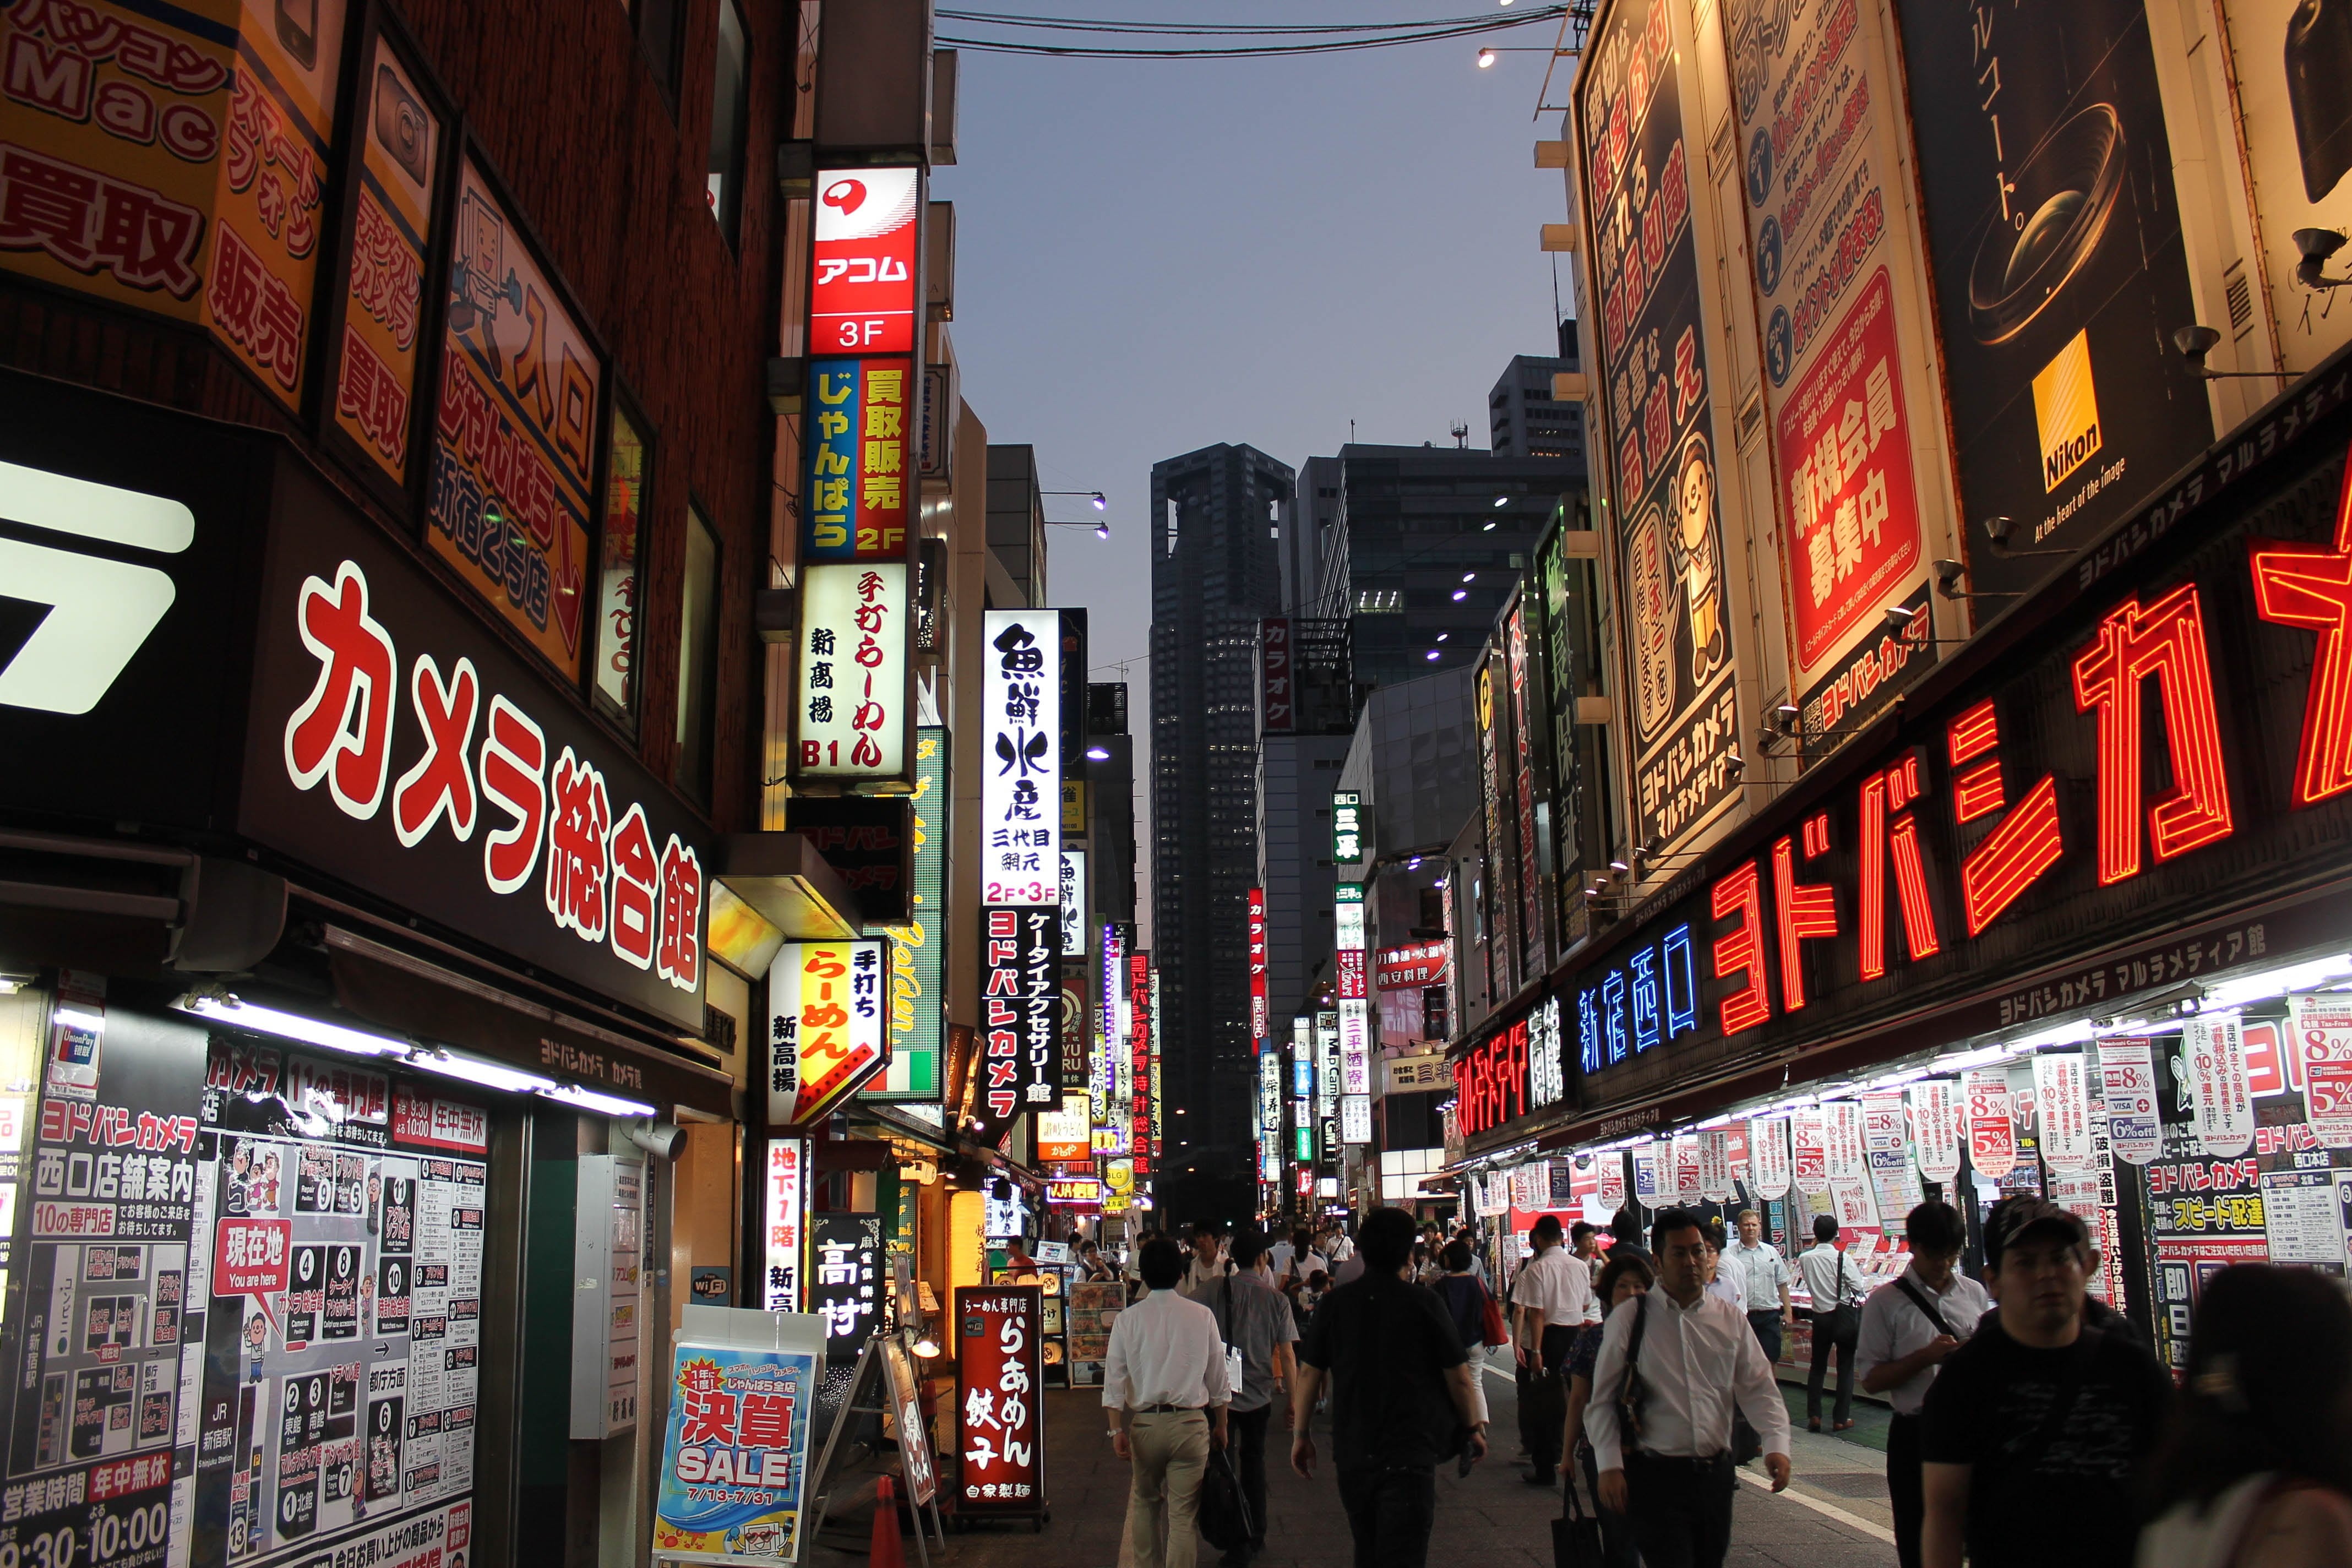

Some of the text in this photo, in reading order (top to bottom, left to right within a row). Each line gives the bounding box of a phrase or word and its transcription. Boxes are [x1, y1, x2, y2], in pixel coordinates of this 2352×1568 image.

[2, 32, 219, 162] Mac
[0, 141, 206, 300] 買取
[1601, 148, 1647, 288] 頼れる
[818, 257, 907, 285] アコム
[1605, 137, 1688, 368] 商品知識
[208, 219, 302, 384] 販売
[839, 320, 884, 347] 3F
[339, 322, 409, 466] 買取
[514, 282, 594, 482] 入口
[1614, 328, 1660, 442] 豊富な
[863, 369, 902, 510] 買取販売
[1620, 323, 1703, 520] 品揃え
[1790, 354, 1898, 540] 新規会員
[2046, 423, 2098, 488] Nikon
[2035, 457, 2125, 544] At the heart of the image
[857, 527, 905, 551] 2F
[1808, 467, 1891, 611] 募集中
[2079, 475, 2204, 591] ヨドバシカメラ
[1646, 526, 1668, 707] 日本一を
[1265, 625, 1290, 721] カラオケ
[993, 623, 1050, 821] 魚鮮水産
[802, 739, 839, 767] B1
[1642, 687, 1734, 816] ヨドバシカメラ
[285, 560, 701, 994] カメラ総合館
[1333, 793, 1359, 806] 西口
[991, 827, 1050, 848] 三代目
[1335, 807, 1359, 859] 三平
[1249, 904, 1265, 974] カラオケ
[1340, 924, 1350, 943] ホール
[1351, 912, 1360, 943] サンパーク
[853, 949, 877, 1018] 手打ち
[1378, 967, 1429, 986] 西安料理
[2000, 923, 2266, 1025] ヨドバシカメラ マルチメディア館
[800, 950, 849, 1060] らーめん
[987, 910, 1017, 1119] ヨドバシカメラ
[1026, 912, 1051, 1103] ケータイアクセサリー館
[1253, 995, 1263, 1039] BIG ECHO
[1580, 922, 1695, 1075] 新宿西口
[63, 1029, 95, 1050] UnionPay
[2321, 1020, 2349, 1028] Tax-Free
[541, 1038, 604, 1078] ヨドバシカメラ
[2304, 1030, 2352, 1061] 8%
[1090, 1055, 1106, 1121] おたからや
[2122, 1067, 2150, 1088] 8%
[410, 1101, 429, 1118] 9:30
[434, 1106, 484, 1142] 年中無休
[1880, 1114, 1901, 1130] 8%
[1970, 1095, 2007, 1117] 8%
[41, 1098, 199, 1155] ヨドバシカメラ
[406, 1120, 429, 1138] 10:00
[1795, 1130, 1823, 1147] 8%
[1975, 1130, 2009, 1153] 5%
[2112, 1119, 2157, 1138] 6%off!
[1797, 1158, 1823, 1175] 5%
[1872, 1154, 1905, 1168] 6%off!
[2095, 1136, 2111, 1168] 破損
[2293, 1151, 2330, 1168] 西口本店
[36, 1147, 195, 1204] 西口店舗案内
[2098, 1170, 2117, 1207] 盗難
[2149, 1157, 2258, 1196] ヨドバシカメラ
[771, 1146, 797, 1248] 地下1階
[2172, 1196, 2265, 1232] スピード配達
[35, 1204, 114, 1234] 10の専門店
[226, 1226, 284, 1268] 現在地
[229, 1273, 277, 1288] You are here
[30, 1315, 43, 1328] JR
[59, 1278, 75, 1334] コンビニ
[965, 1297, 1028, 1314] らーめん専門店
[24, 1332, 41, 1389] 新宿駅
[369, 1366, 406, 1393] 都庁方面
[690, 1369, 715, 1379] 1年に
[999, 1316, 1031, 1468] らあめん
[213, 1402, 228, 1422] JR
[284, 1409, 325, 1437] 東館 南館
[679, 1390, 796, 1451] 決算
[203, 1427, 232, 1451] 新宿駅
[676, 1446, 790, 1488] SALE
[2, 1457, 167, 1523] 営業時間 年中無休
[297, 1490, 313, 1513] 北館
[687, 1488, 774, 1506] 7/13-7/31
[966, 1483, 1031, 1498] 自家製麺
[88, 1503, 106, 1520] よる
